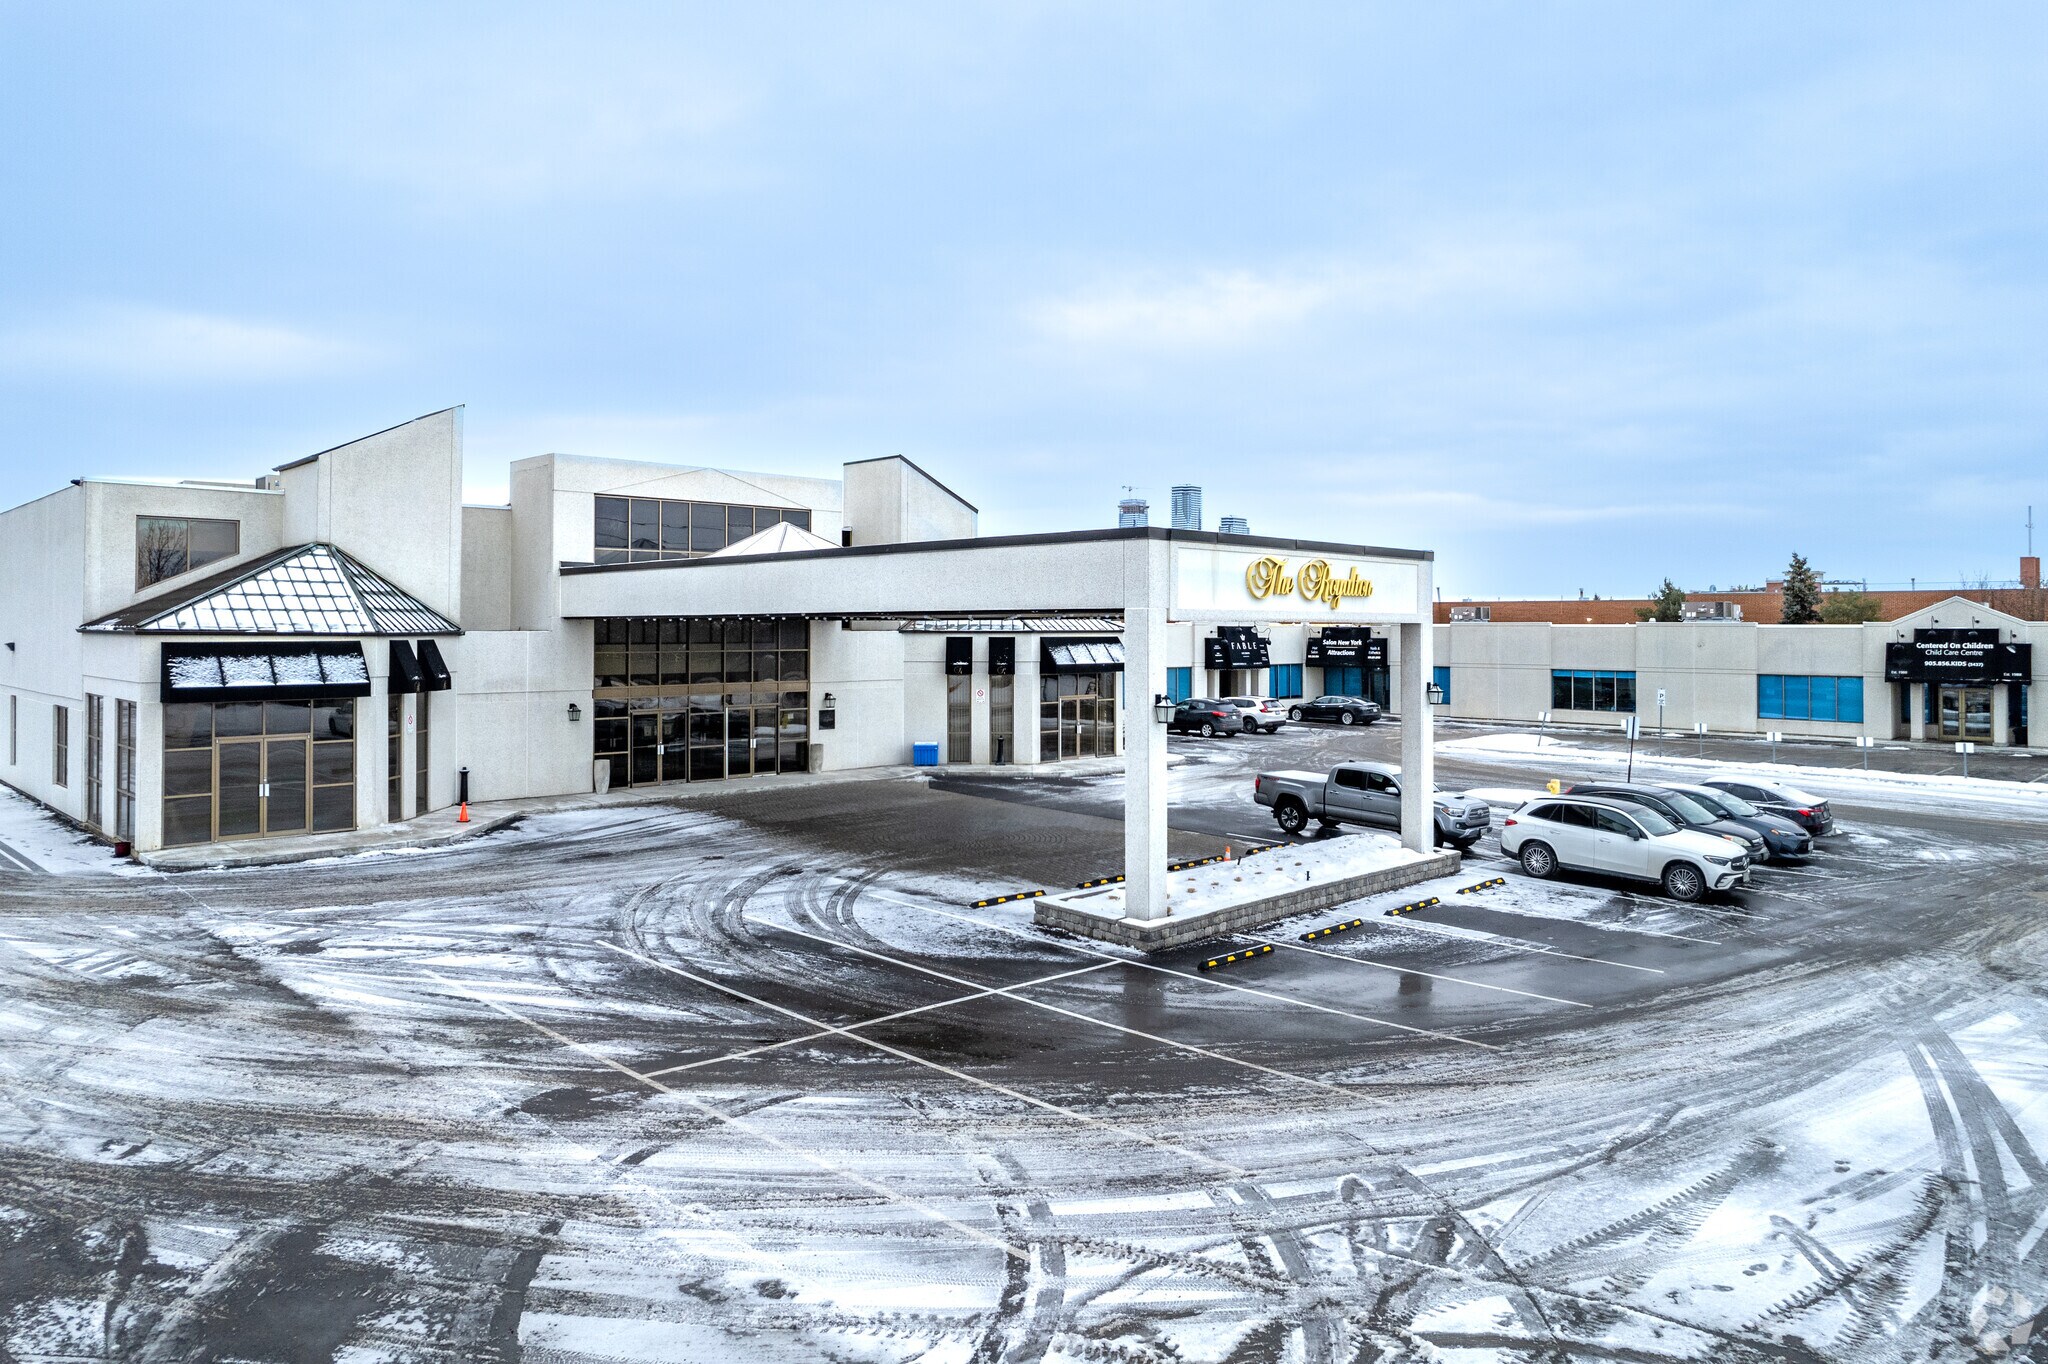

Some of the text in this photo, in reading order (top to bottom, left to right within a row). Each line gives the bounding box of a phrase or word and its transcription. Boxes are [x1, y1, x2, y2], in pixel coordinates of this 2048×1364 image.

[1245, 555, 1373, 610] The Royalton
[1231, 642, 1257, 650] FABLE
